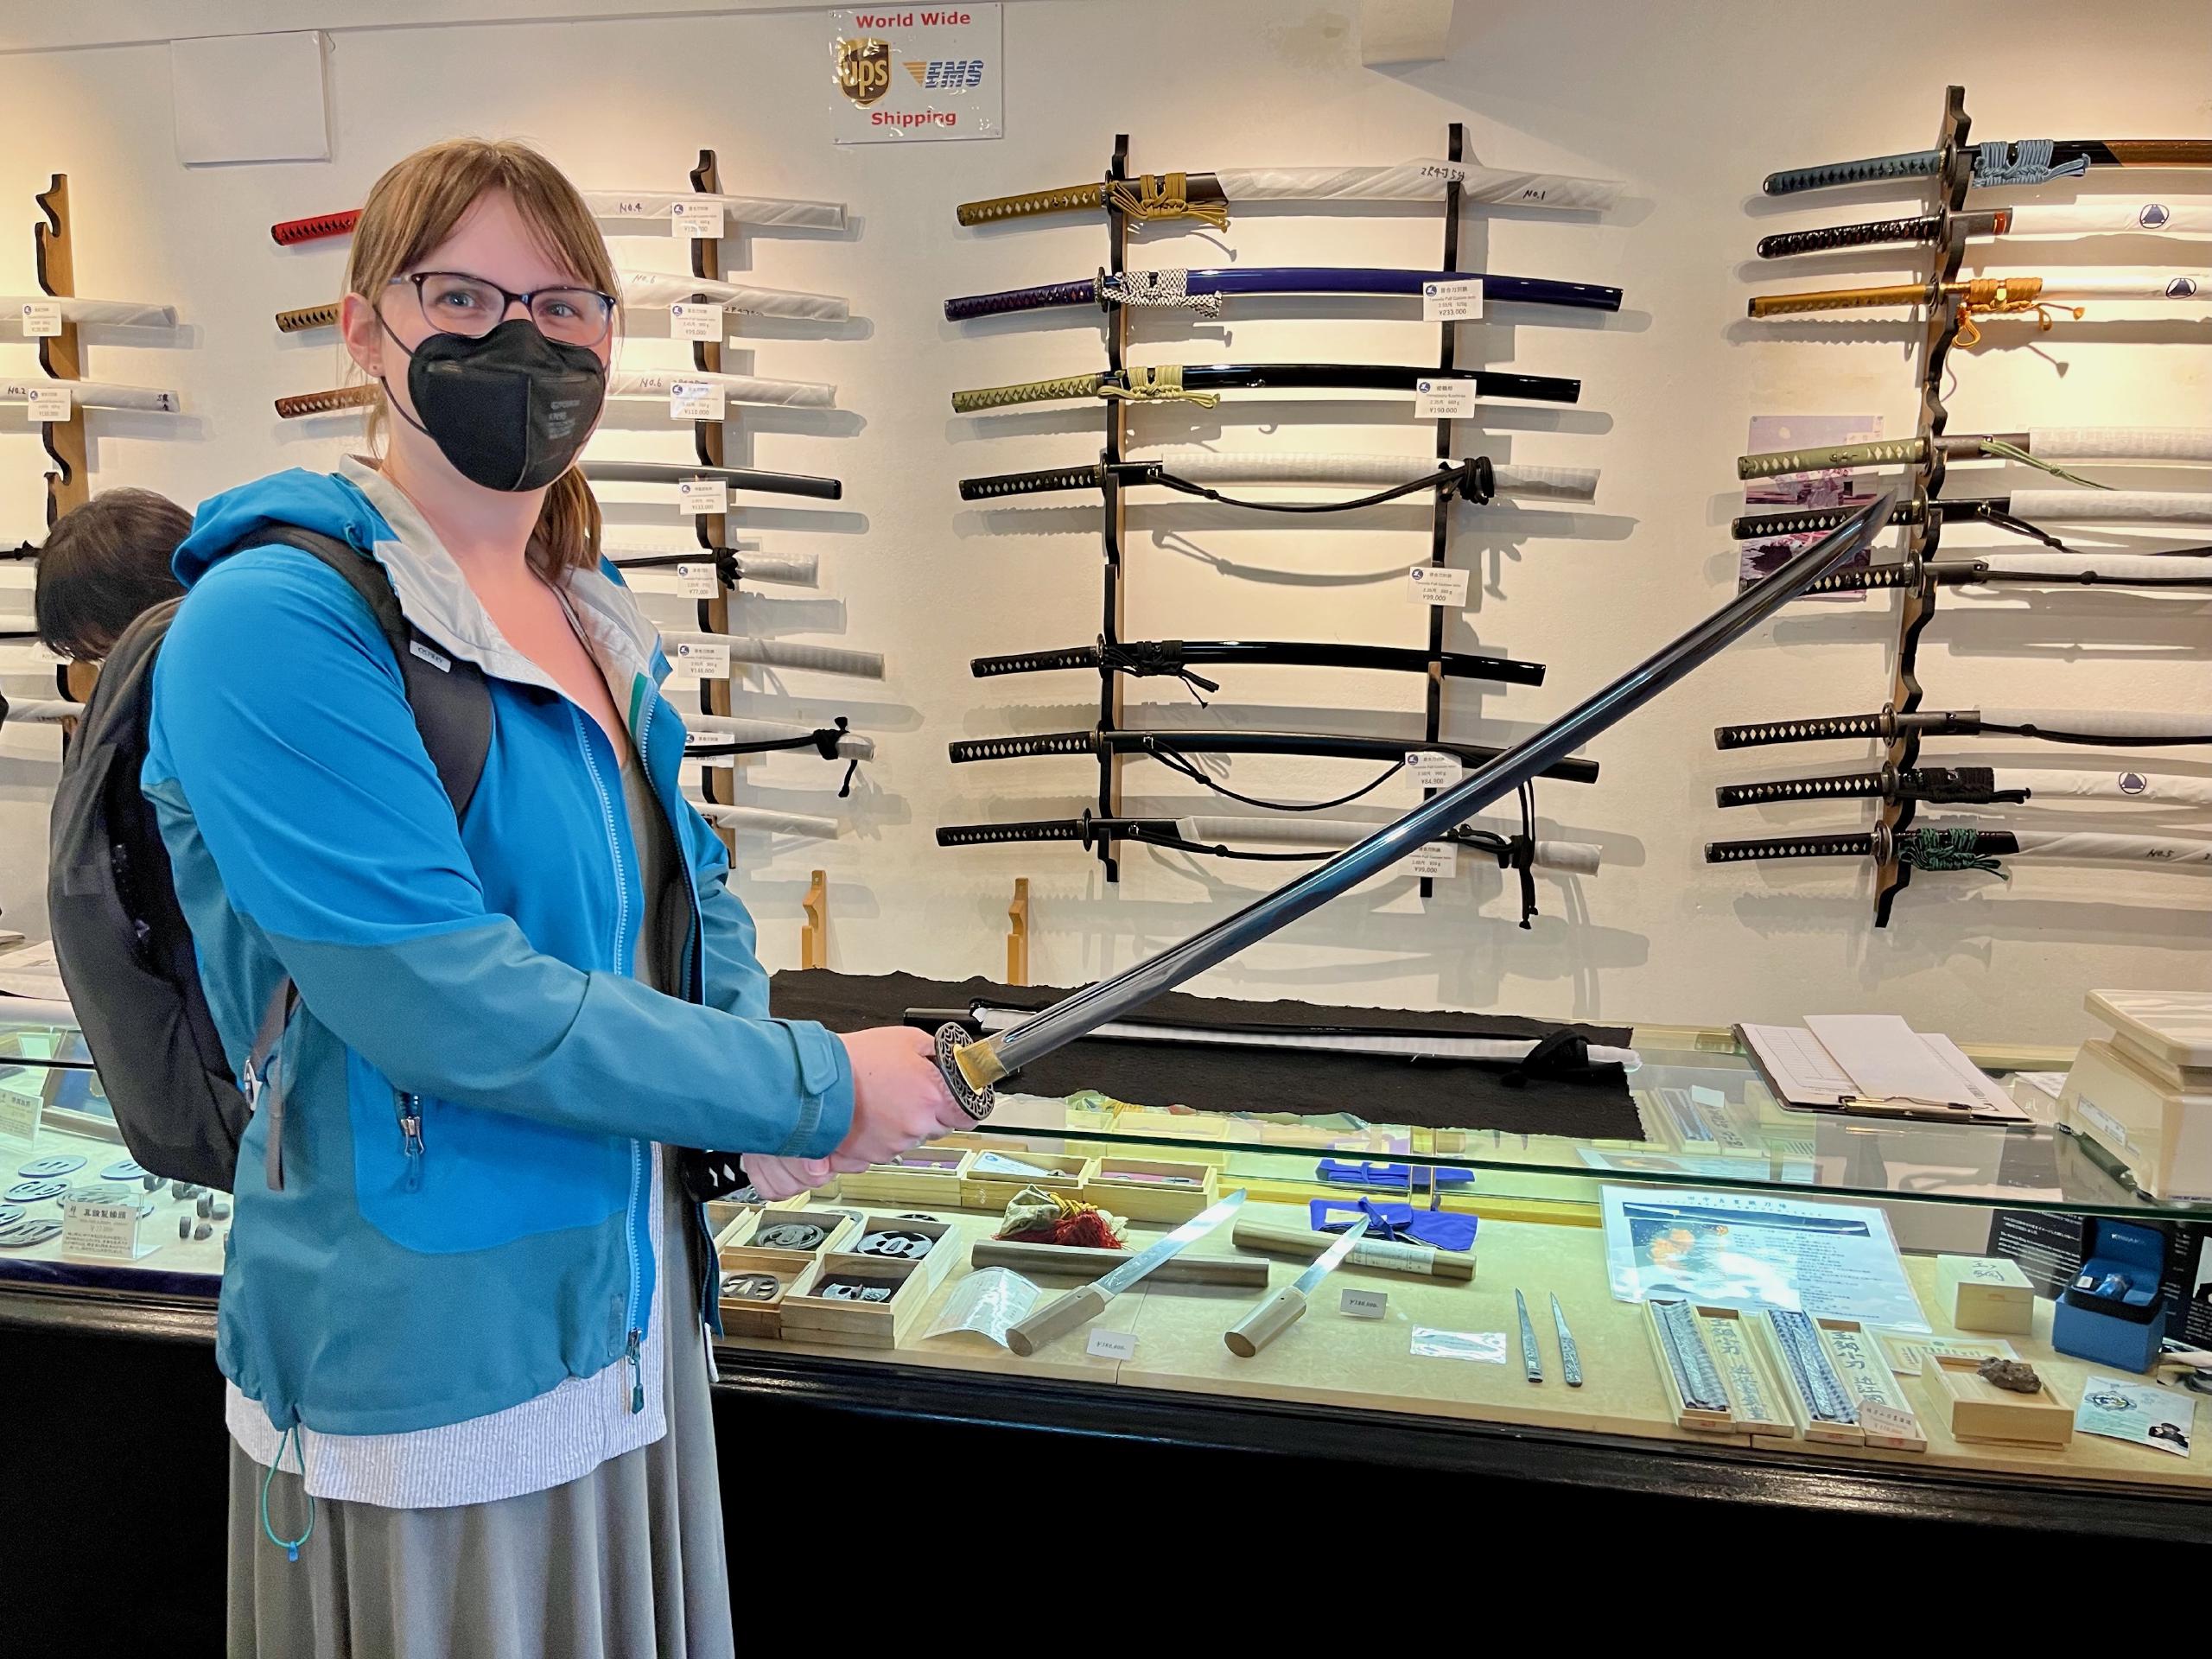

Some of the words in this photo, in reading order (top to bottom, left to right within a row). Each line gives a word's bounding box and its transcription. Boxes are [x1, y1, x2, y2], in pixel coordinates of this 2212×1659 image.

[855, 13, 913, 29] World
[920, 11, 971, 26] Wide
[925, 60, 984, 88] EMS
[871, 111, 957, 128] Shipping
